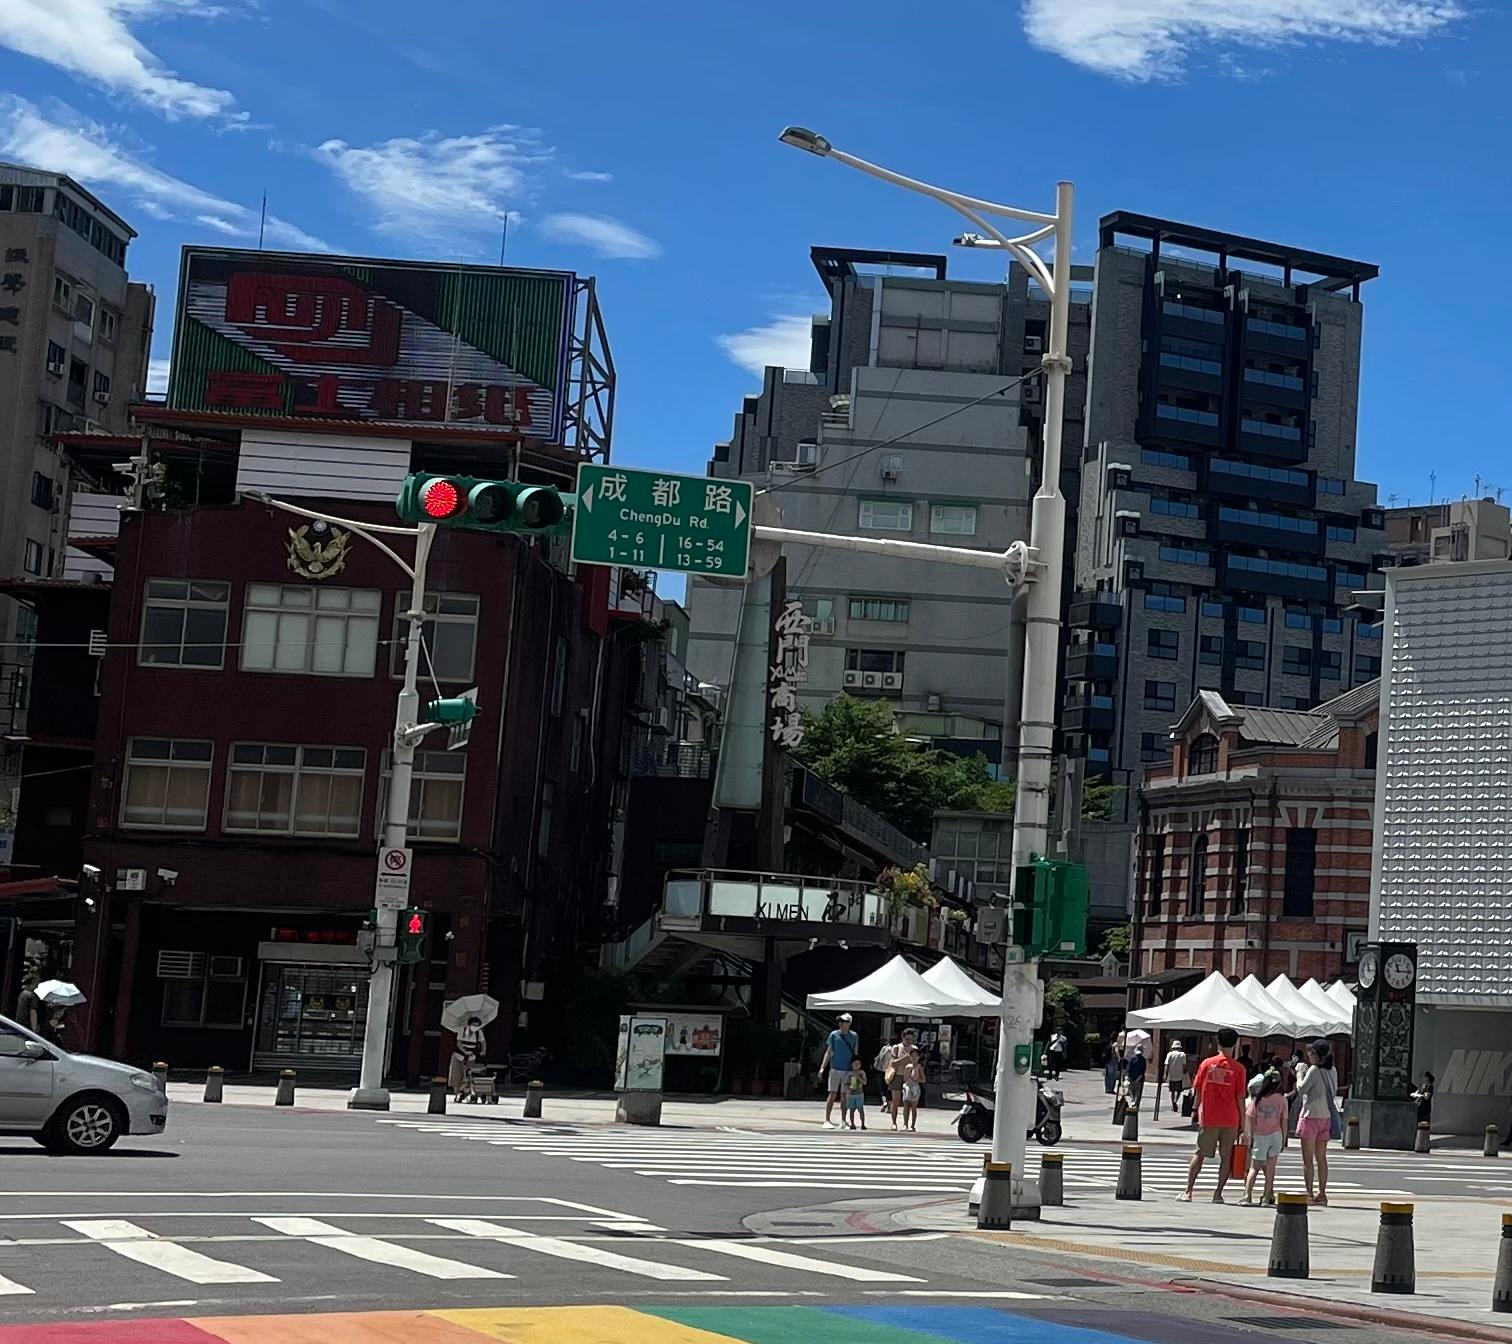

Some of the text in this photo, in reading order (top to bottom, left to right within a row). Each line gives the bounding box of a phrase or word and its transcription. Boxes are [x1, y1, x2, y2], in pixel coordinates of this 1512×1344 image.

[598, 473, 732, 514] 成都路
[619, 508, 681, 527] ChengDu
